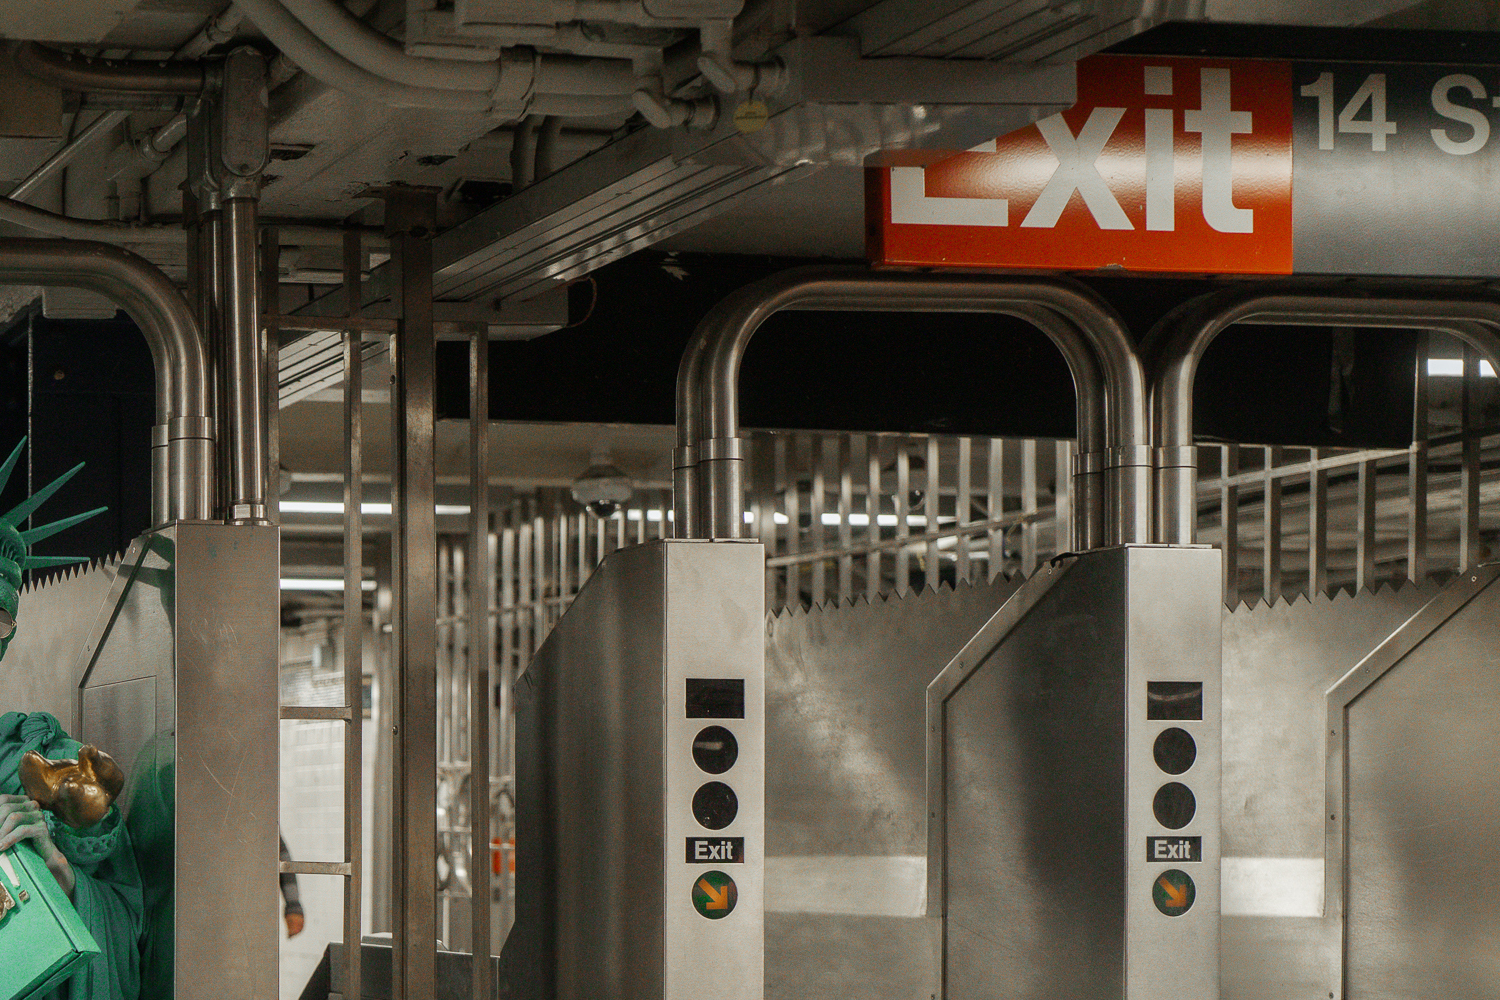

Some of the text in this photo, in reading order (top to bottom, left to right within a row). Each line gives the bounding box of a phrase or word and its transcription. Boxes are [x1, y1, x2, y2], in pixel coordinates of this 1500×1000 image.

[1300, 71, 1500, 155] 14 S
[694, 840, 733, 860] Exit
[1154, 839, 1191, 859] Exit
